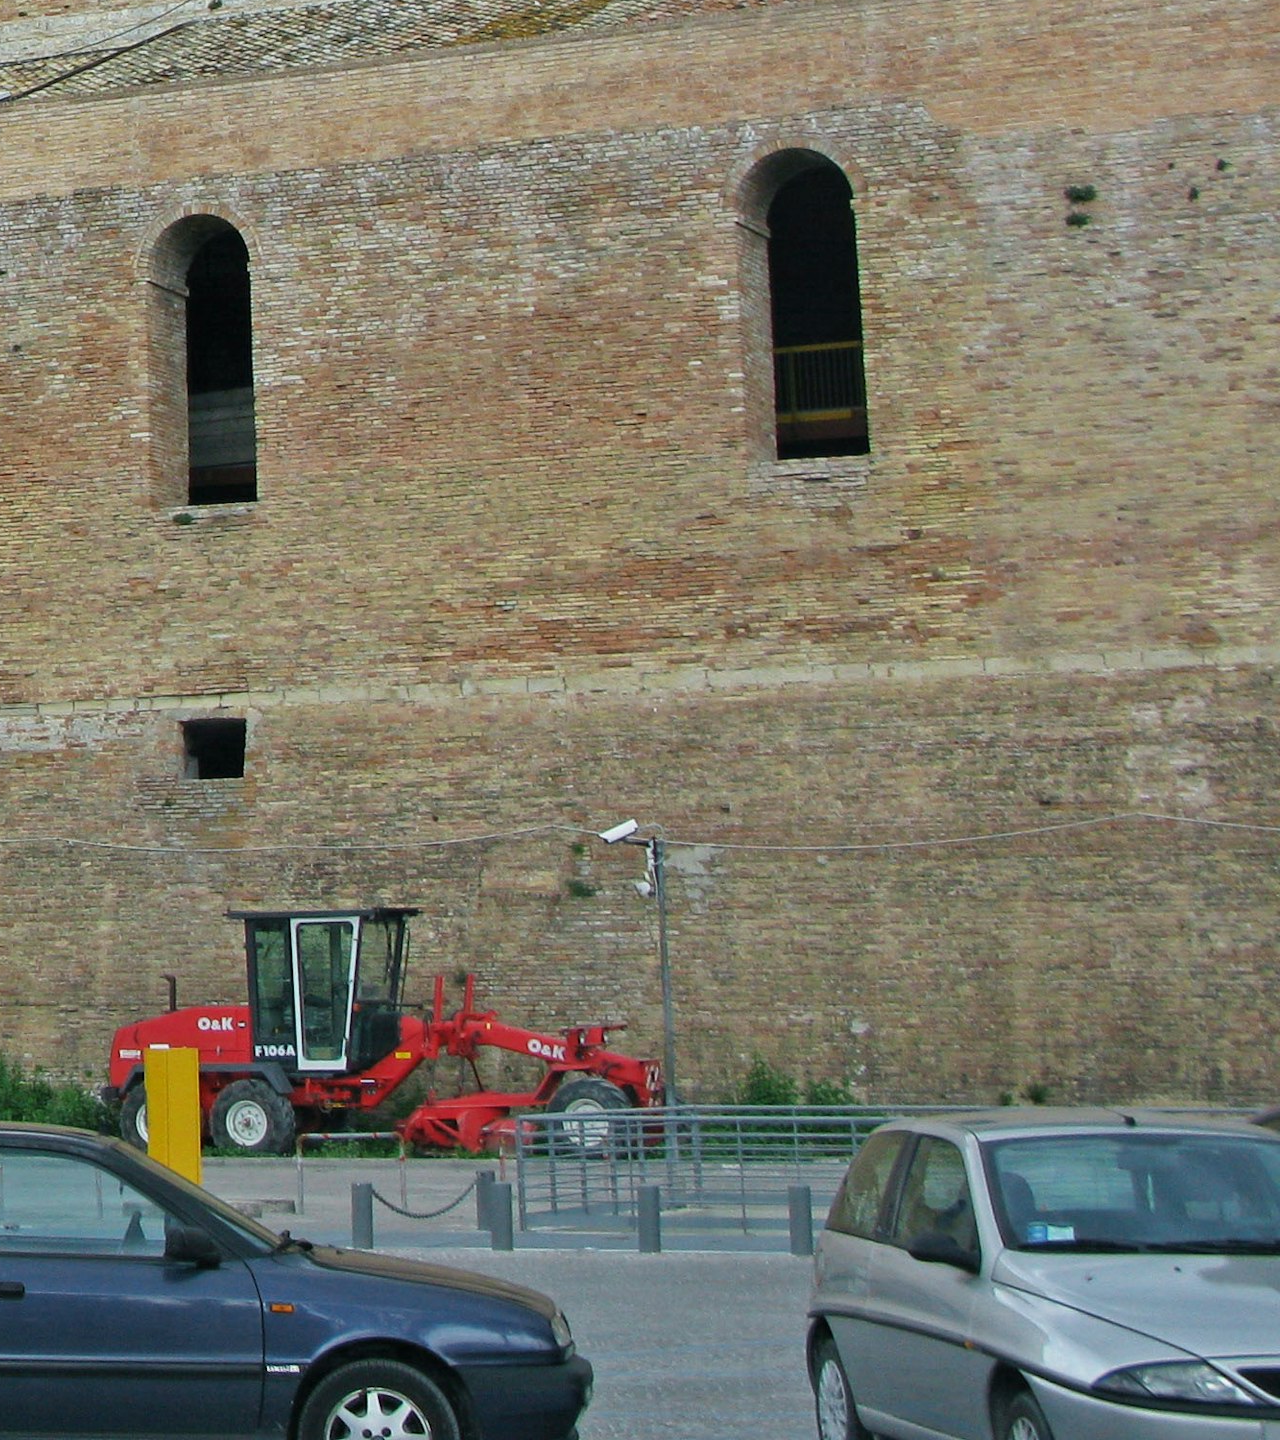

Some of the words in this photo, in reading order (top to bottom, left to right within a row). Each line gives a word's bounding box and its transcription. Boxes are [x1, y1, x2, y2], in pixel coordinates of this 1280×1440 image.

[197, 1016, 234, 1031] O&K
[254, 1044, 296, 1058] F106A
[526, 1038, 565, 1061] O&K
